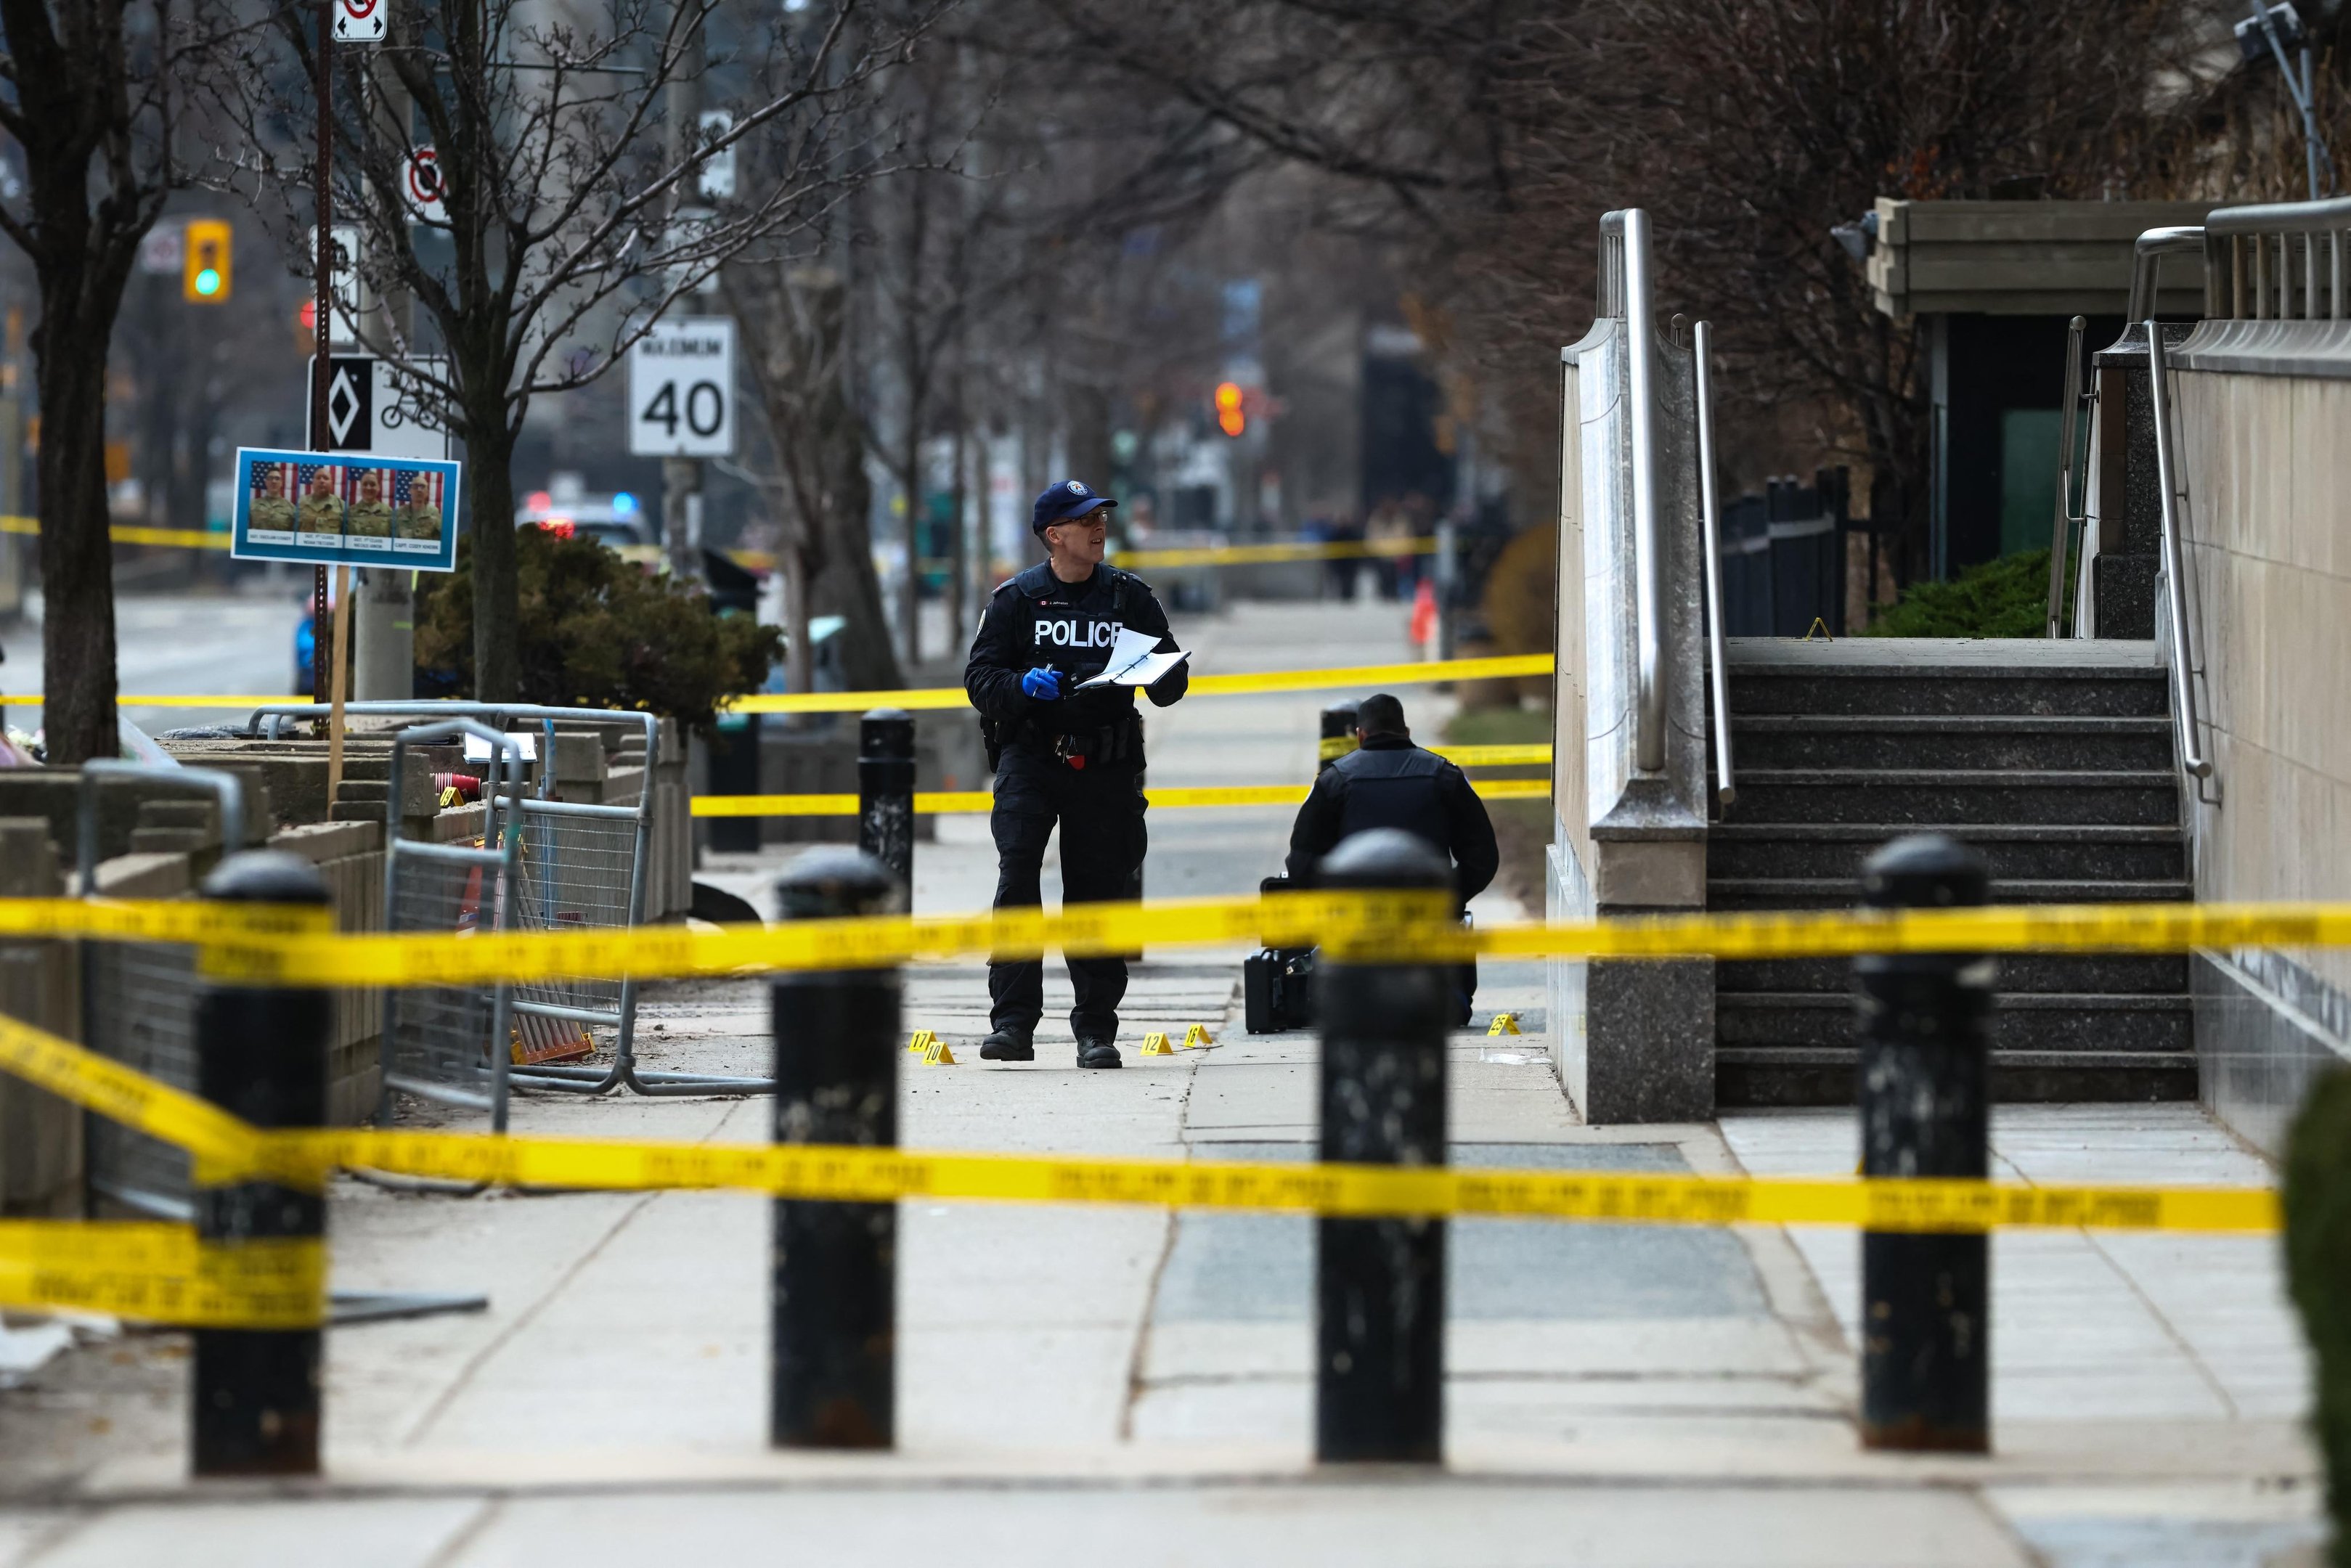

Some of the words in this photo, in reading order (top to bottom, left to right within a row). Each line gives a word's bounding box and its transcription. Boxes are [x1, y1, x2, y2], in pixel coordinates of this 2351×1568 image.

[642, 380, 723, 438] 40
[1035, 621, 1123, 648] POLICE
[1491, 1017, 1506, 1030] 25
[913, 1034, 928, 1048] 17
[1145, 1035, 1160, 1050] 12
[1187, 1027, 1198, 1043] 16
[926, 1045, 941, 1060] 10
